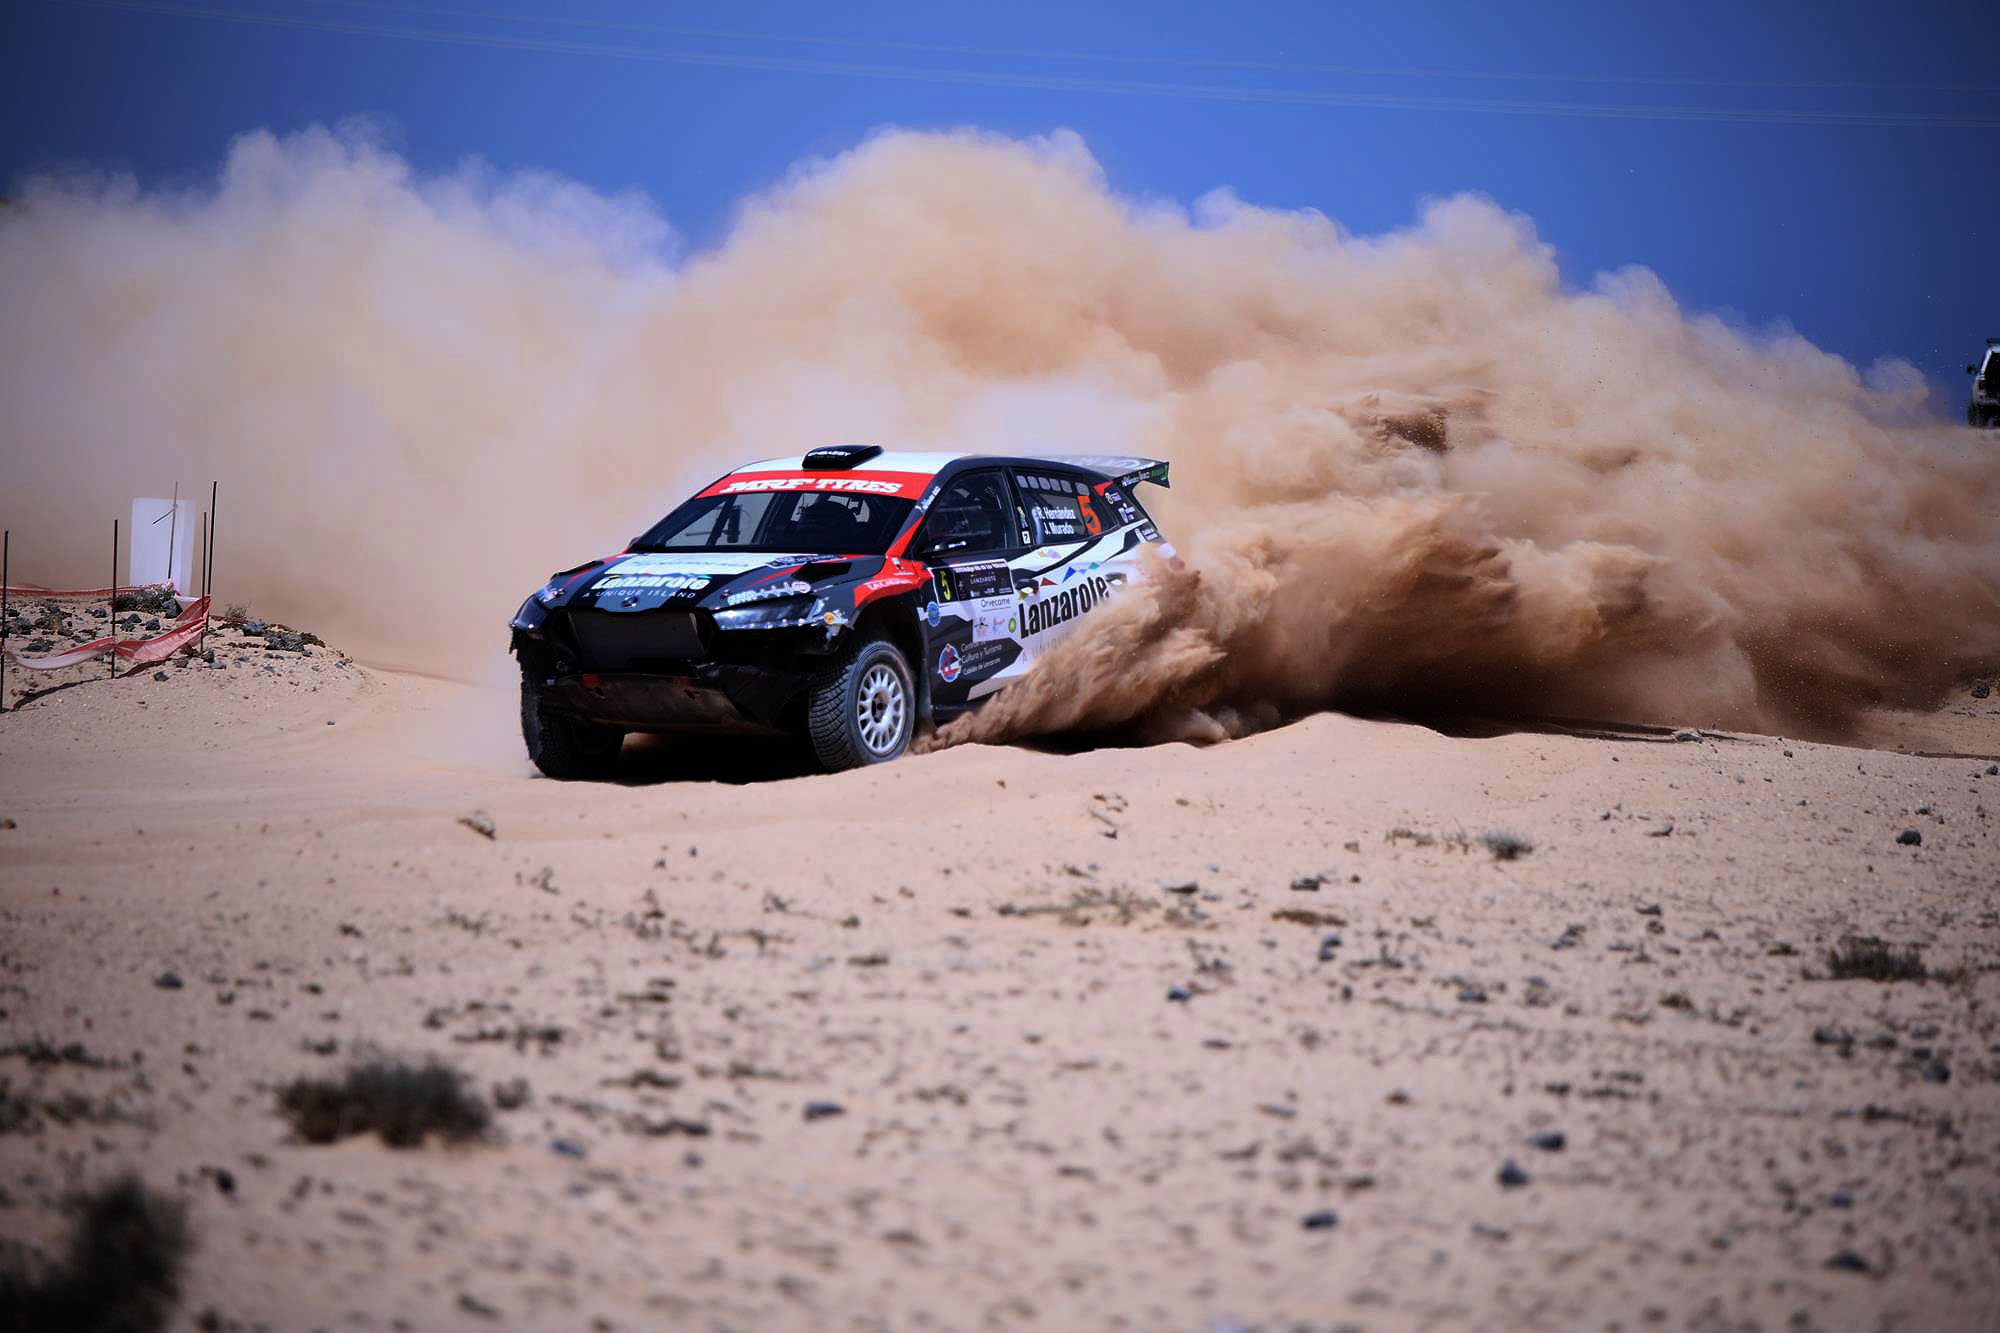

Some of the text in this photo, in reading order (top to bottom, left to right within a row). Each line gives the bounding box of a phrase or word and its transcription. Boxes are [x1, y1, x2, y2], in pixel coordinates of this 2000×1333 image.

[719, 478, 902, 495] MRF TYRES
[1077, 495, 1102, 535] 5
[591, 575, 712, 591] Lanzarote
[595, 588, 644, 597] UNIQUE
[647, 589, 697, 600] ISLAND
[940, 570, 952, 601] 5
[1018, 575, 1110, 640] Lanzarote
